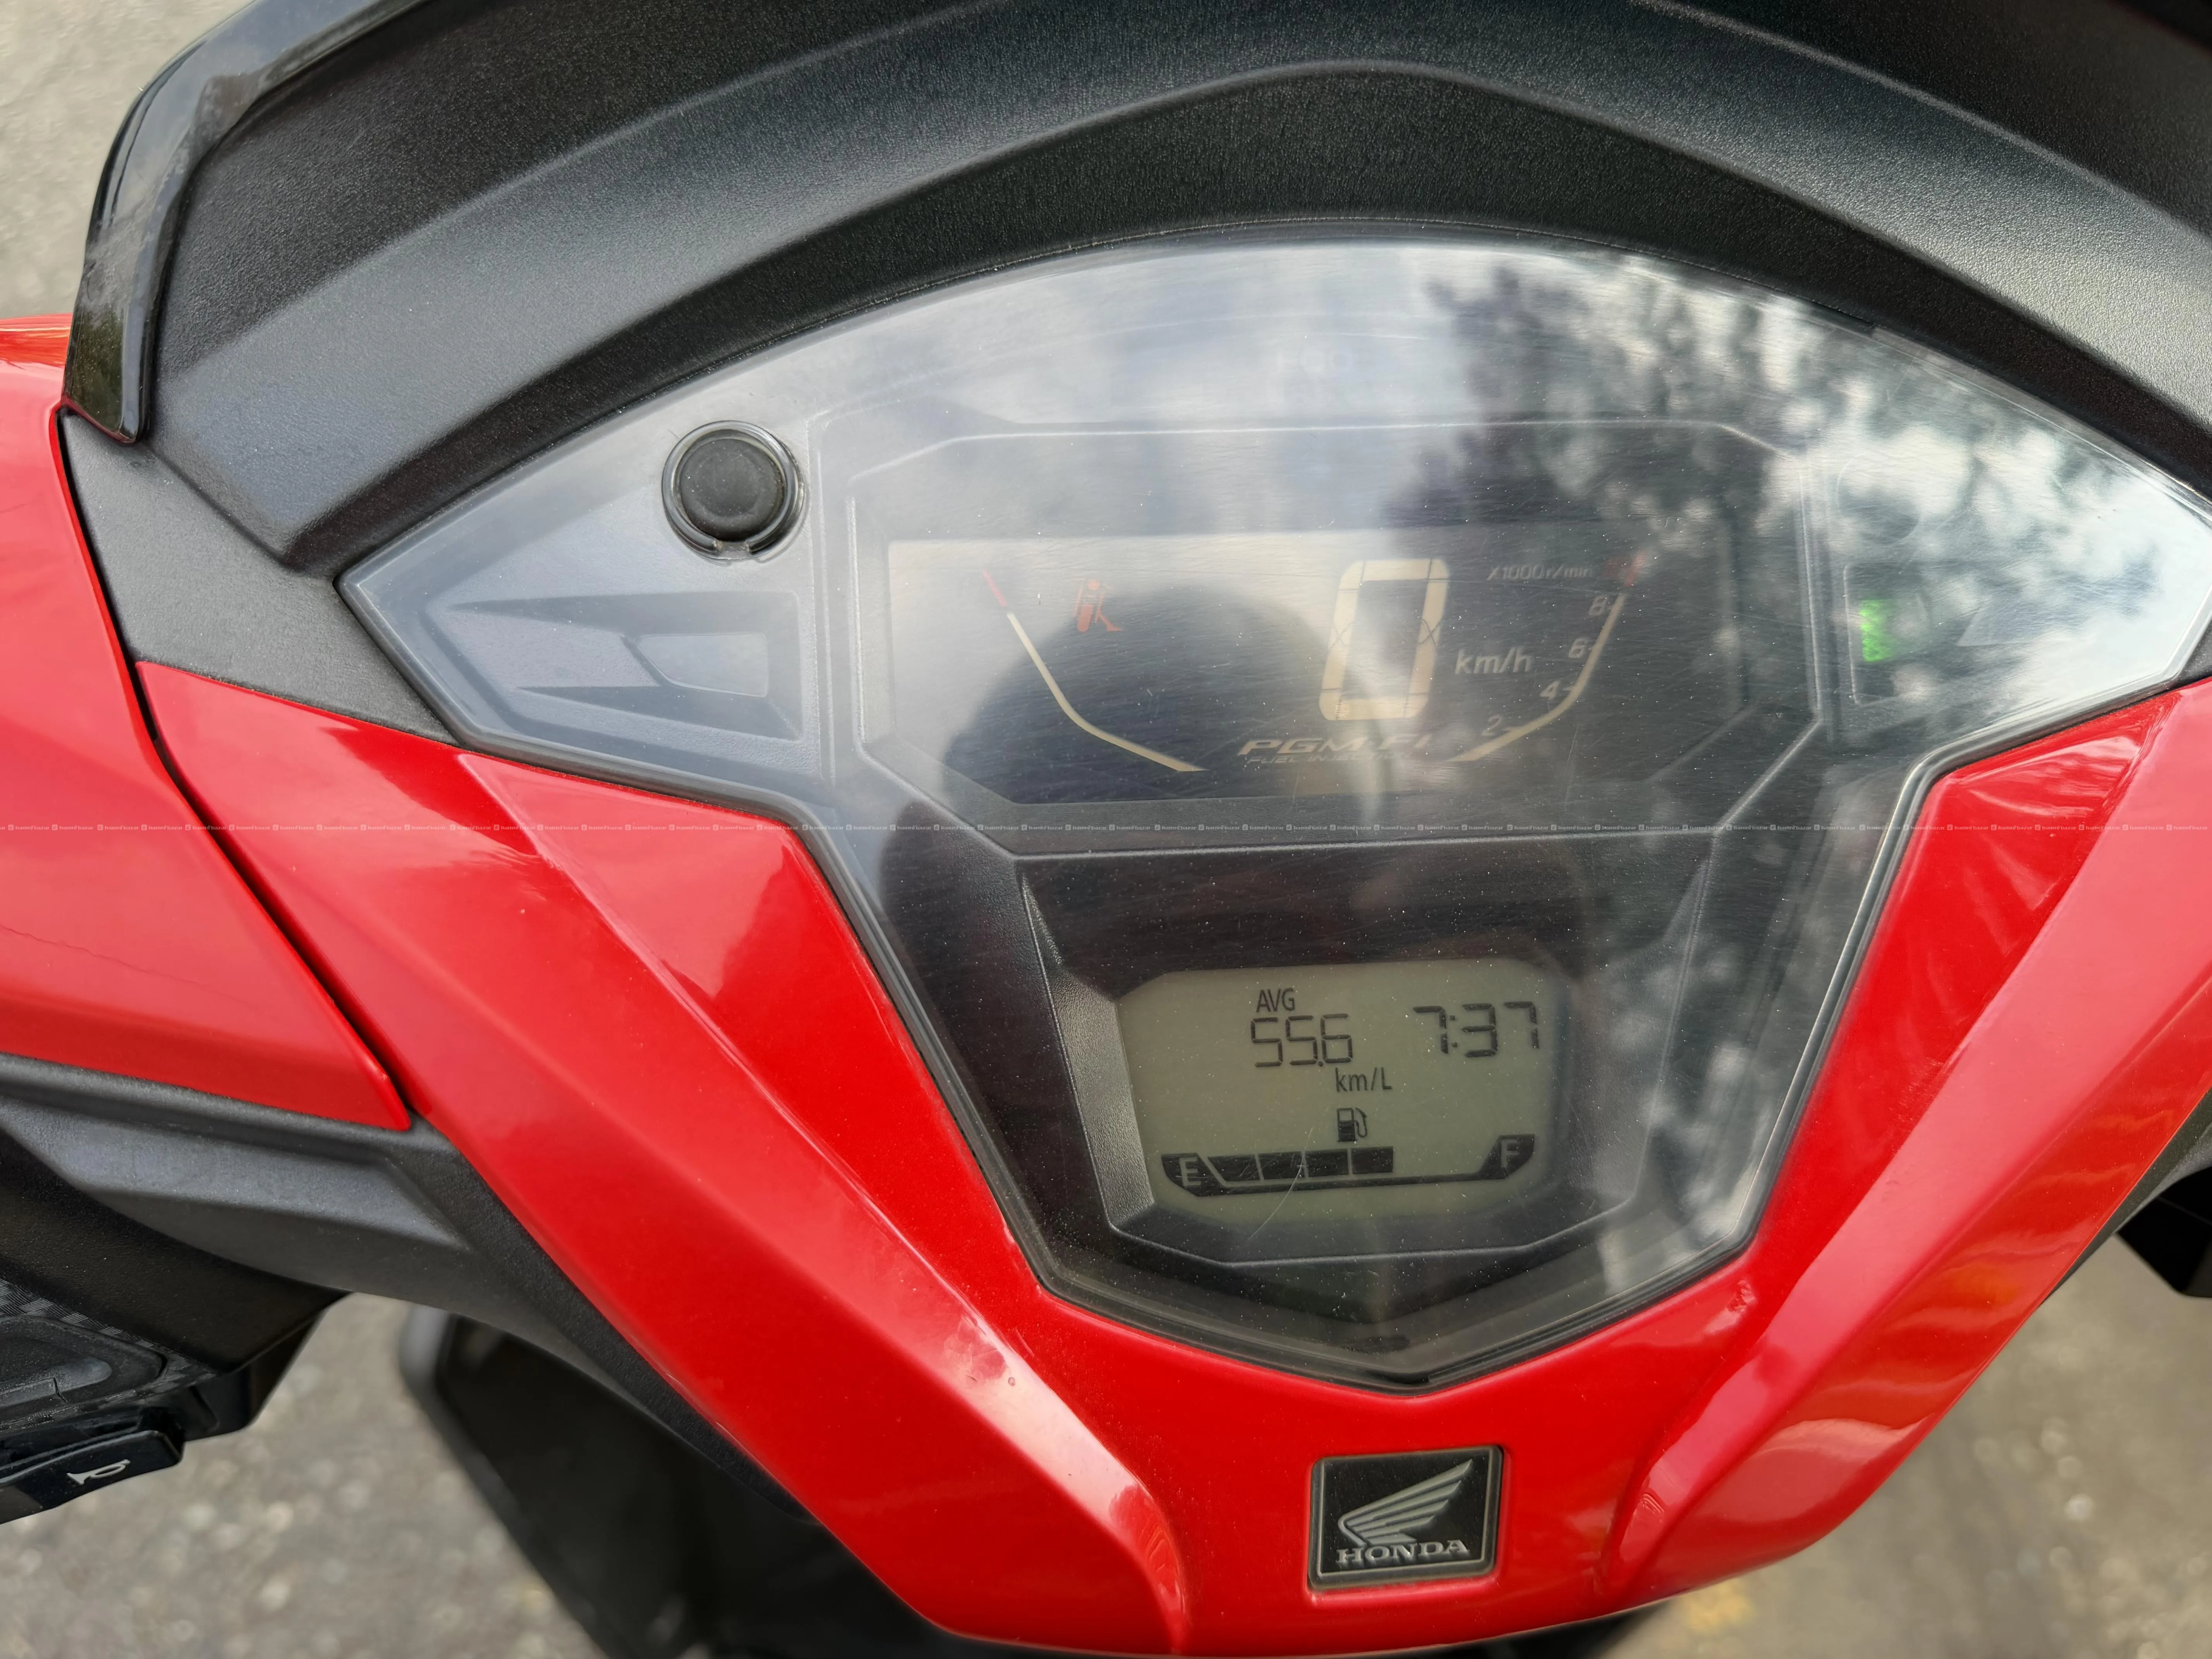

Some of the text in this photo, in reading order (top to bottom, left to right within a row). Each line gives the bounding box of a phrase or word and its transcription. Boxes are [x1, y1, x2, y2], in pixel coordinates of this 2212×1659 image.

[1588, 595, 1608, 616] 8
[1319, 558, 1449, 720] 0
[1568, 637, 1588, 658] 6
[1455, 646, 1534, 675] km/h
[1539, 680, 1561, 699] 4
[1482, 714, 1504, 736] 2
[1256, 988, 1296, 1012] AVG
[1413, 1001, 1540, 1057] 7:37
[1335, 1067, 1392, 1092] km/L
[1500, 1138, 1520, 1167] F
[1180, 1157, 1201, 1186] E
[1336, 1539, 1470, 1563] HONDA
